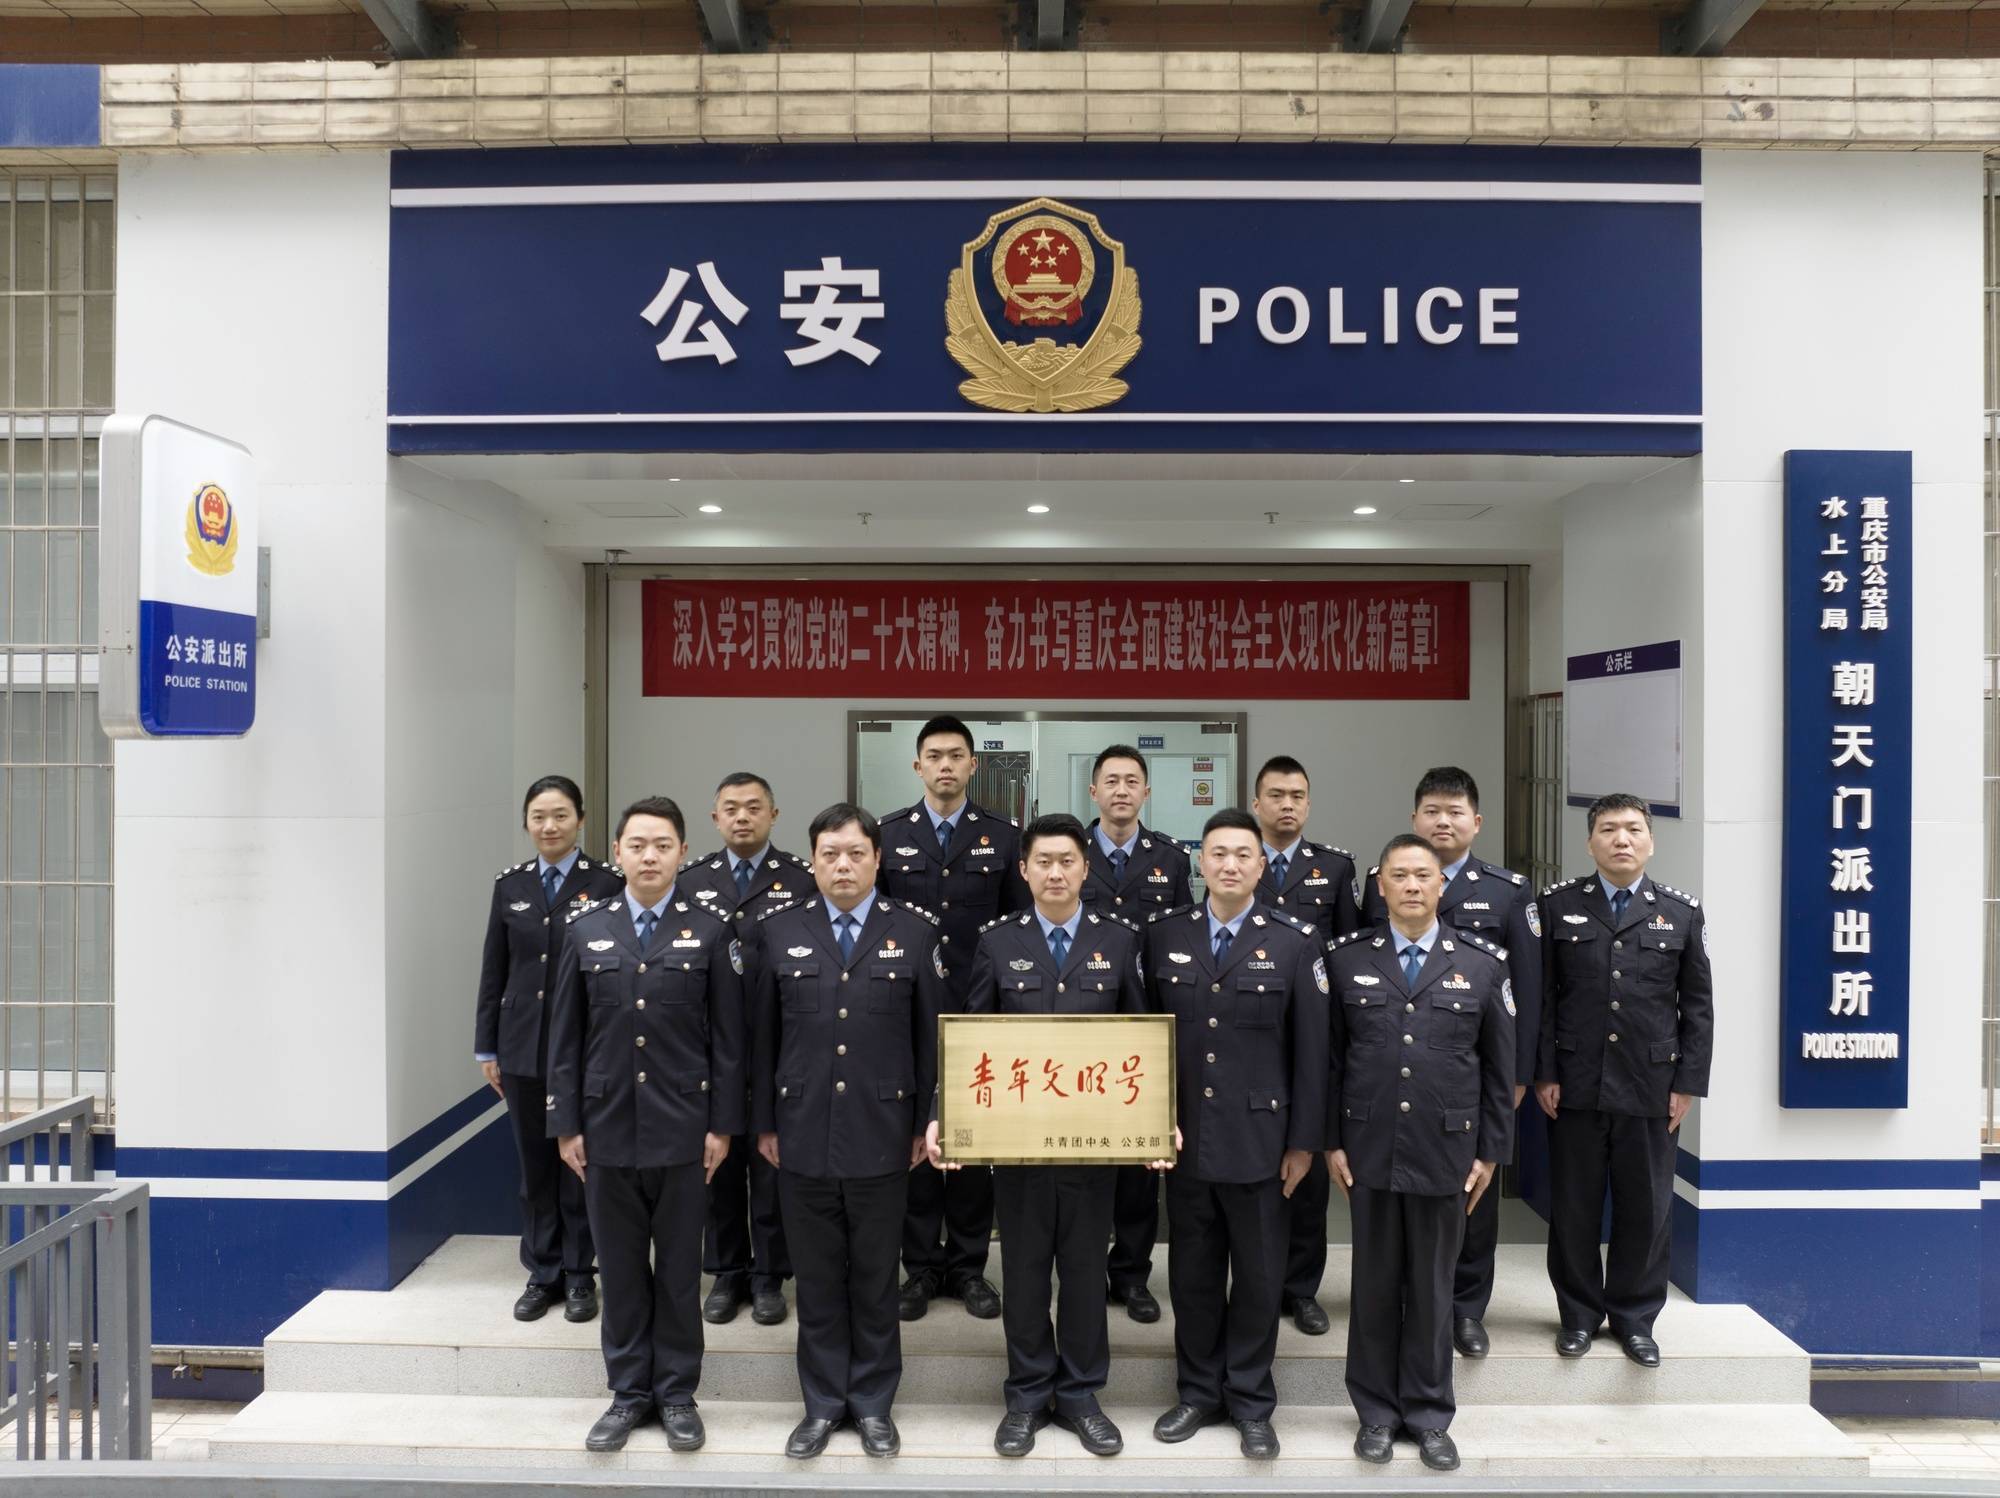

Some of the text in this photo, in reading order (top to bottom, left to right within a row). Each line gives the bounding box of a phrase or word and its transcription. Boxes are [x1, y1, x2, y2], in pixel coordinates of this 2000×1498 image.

[640, 256, 885, 366] 公安
[1199, 286, 1519, 345] POLICE
[1820, 496, 1849, 630] 水上分局
[1860, 496, 1889, 630] 重庆市公安局
[166, 635, 248, 669] 公安派出所
[1605, 651, 1633, 672] 公示栏
[165, 675, 248, 693] POLICE STATION
[1829, 661, 1875, 1017] 朝天门派出所
[969, 1052, 1145, 1108] 青年文明号
[1043, 1136, 1161, 1148] 共青团中央 公安部
